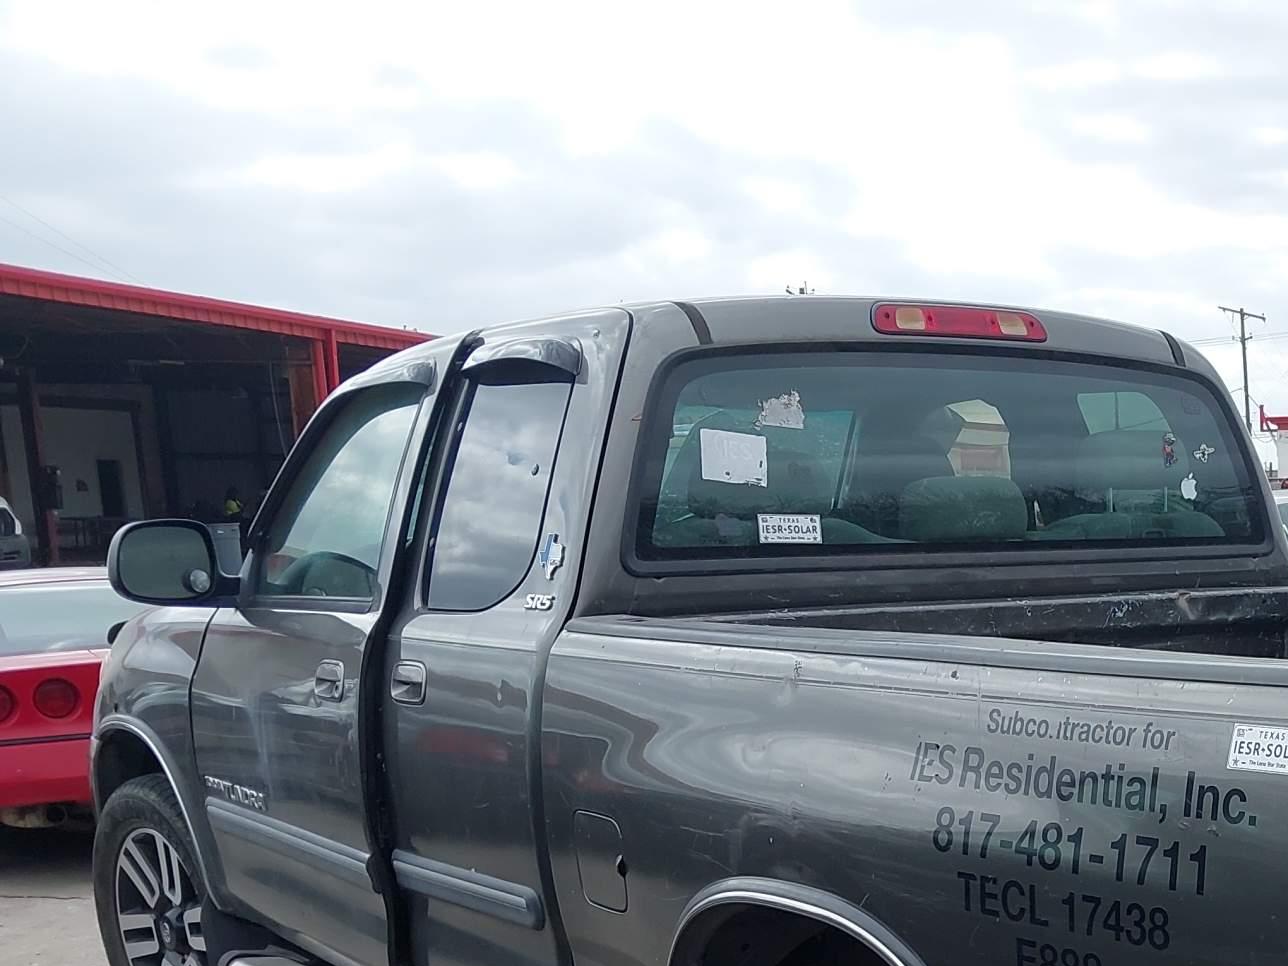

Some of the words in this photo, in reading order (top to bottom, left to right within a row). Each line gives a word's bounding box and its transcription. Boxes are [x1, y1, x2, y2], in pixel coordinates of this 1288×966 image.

[523, 593, 554, 610] SR5
[1141, 721, 1177, 752] for
[1258, 730, 1287, 741] TEXAS
[909, 741, 956, 785] IES
[958, 746, 1169, 824] Residential,
[1182, 770, 1258, 827] Inc.
[931, 805, 1210, 897] 817-481-1711
[956, 871, 1050, 928] TECL
[1061, 891, 1171, 951] 17438
